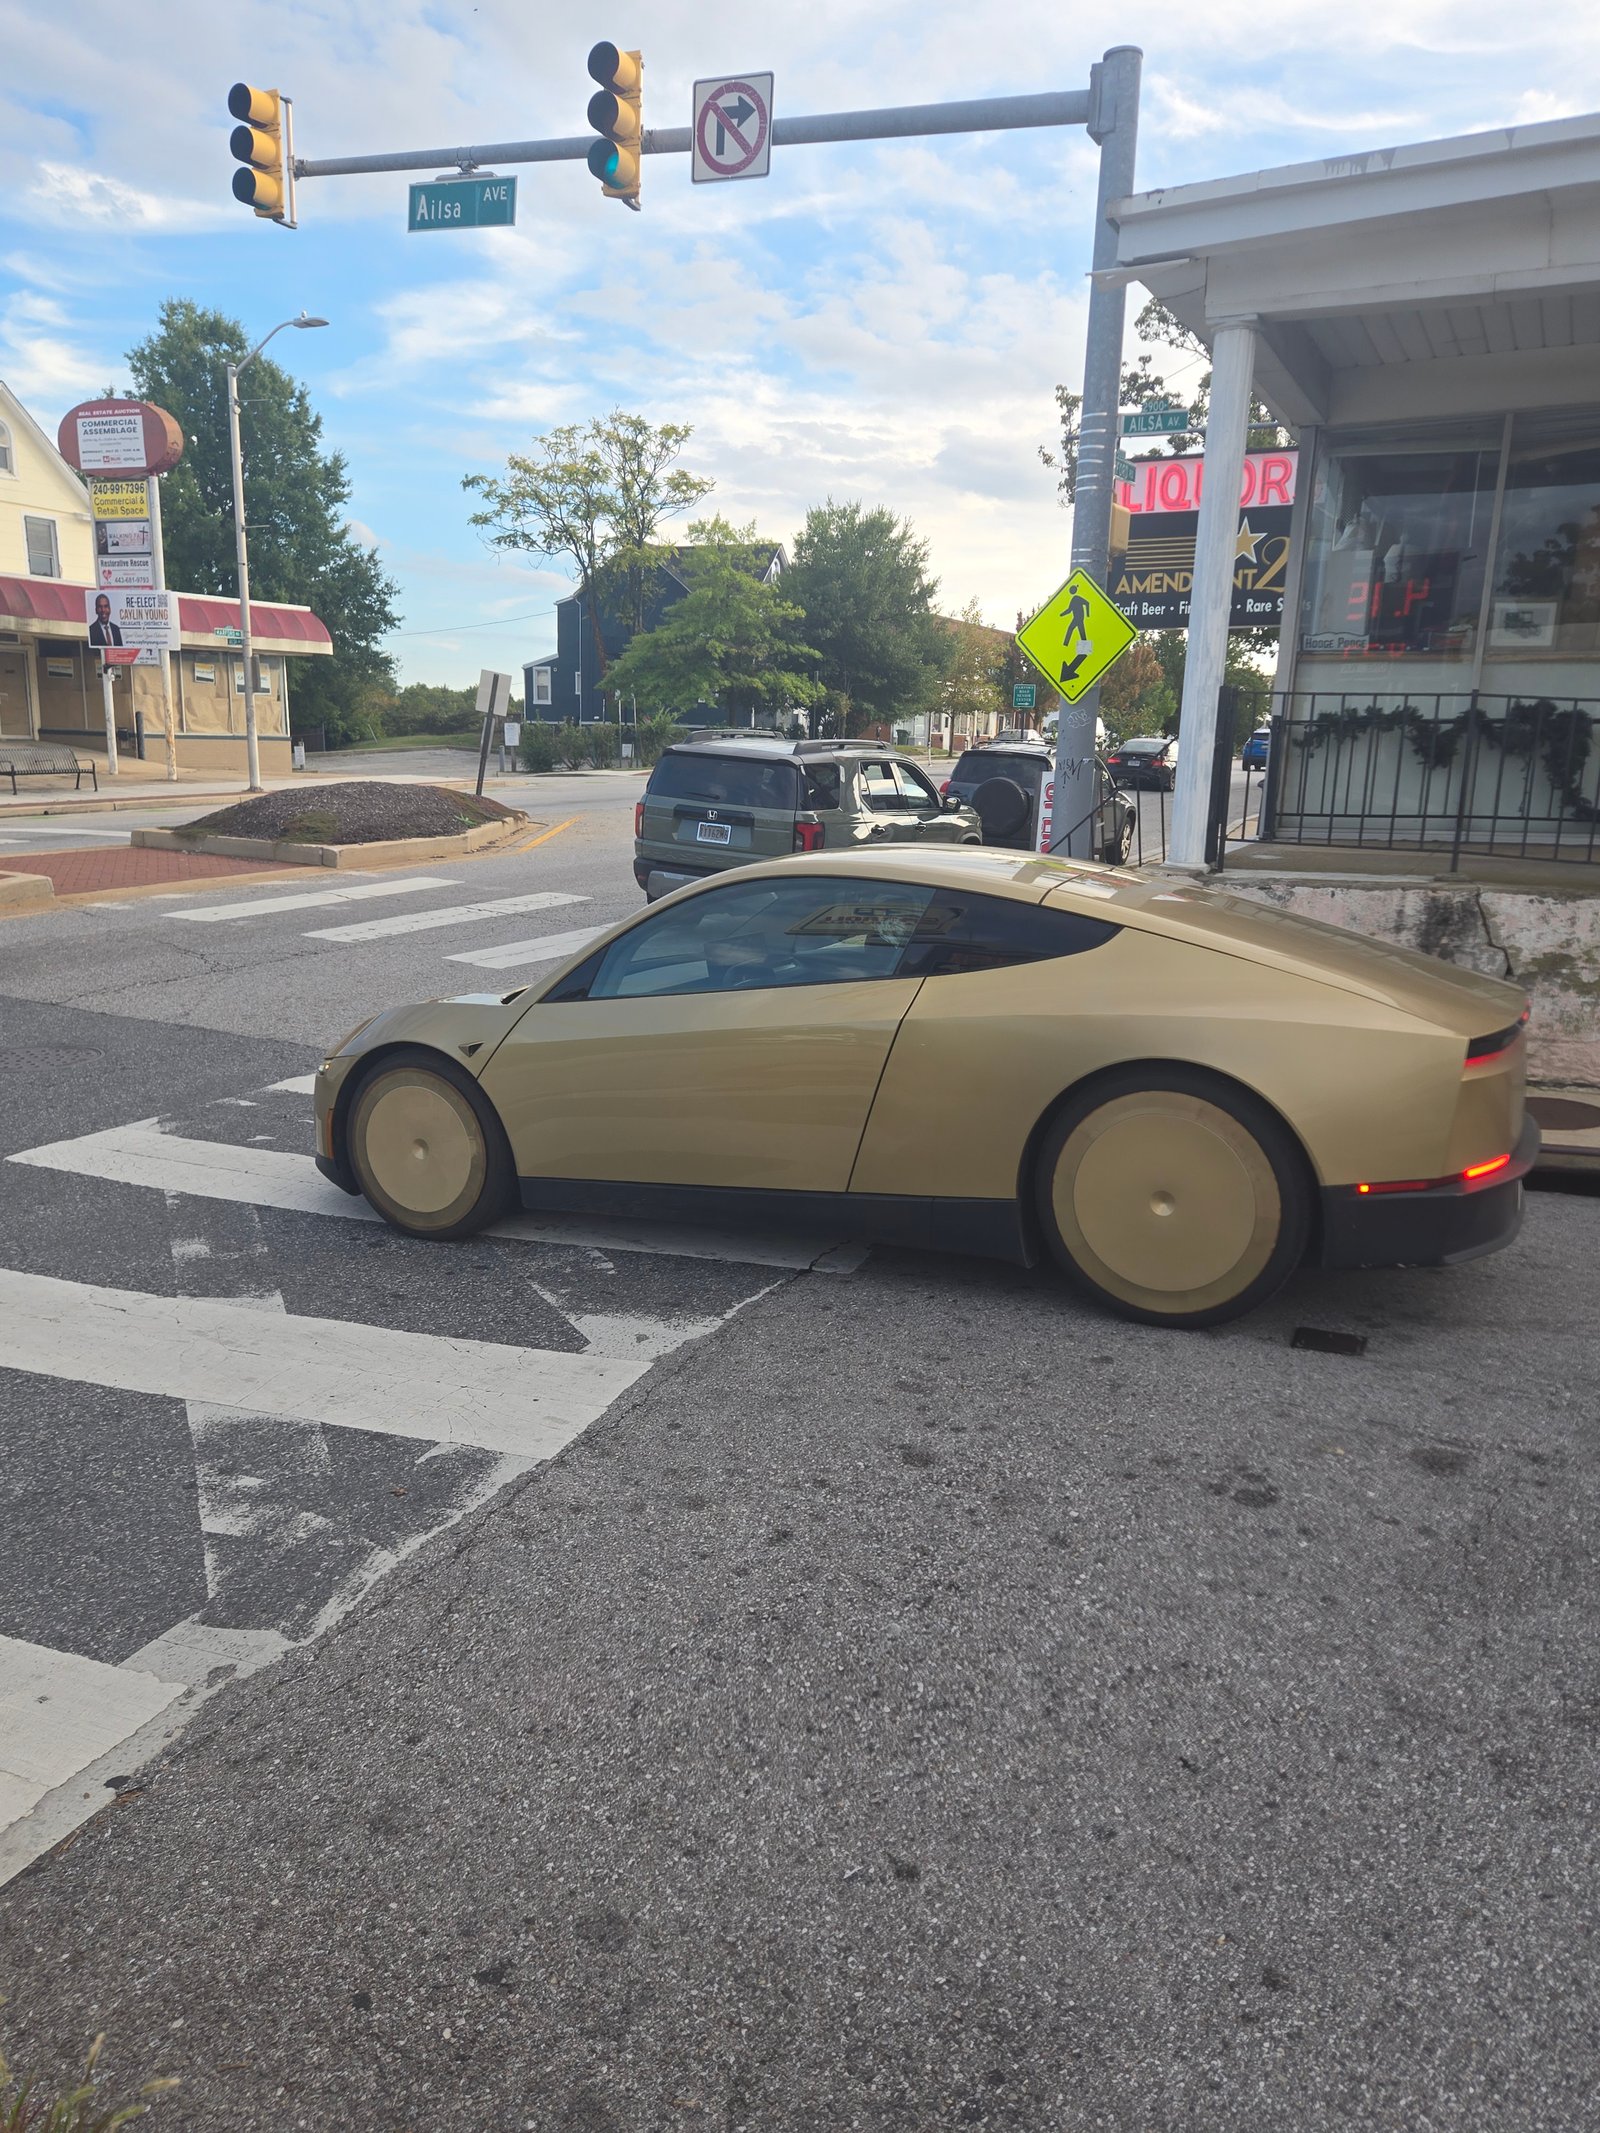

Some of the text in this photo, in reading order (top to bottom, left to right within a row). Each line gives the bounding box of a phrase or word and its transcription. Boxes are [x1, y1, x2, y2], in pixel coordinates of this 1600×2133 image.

[417, 186, 508, 221] Ailsa AVE
[81, 419, 138, 428] COMMERCIAL
[1129, 415, 1163, 432] AILSA
[83, 427, 138, 436] ASSEMBLAGE
[93, 483, 145, 495] 240-991-7396
[94, 496, 145, 506] Commercial &
[97, 506, 144, 516] Retail Space
[130, 559, 149, 568] Rescue
[126, 597, 156, 608] RE-ELECT
[1142, 602, 1166, 616] Beer
[1246, 599, 1272, 613] Rare
[120, 609, 168, 620] CAYLIN YOUNG
